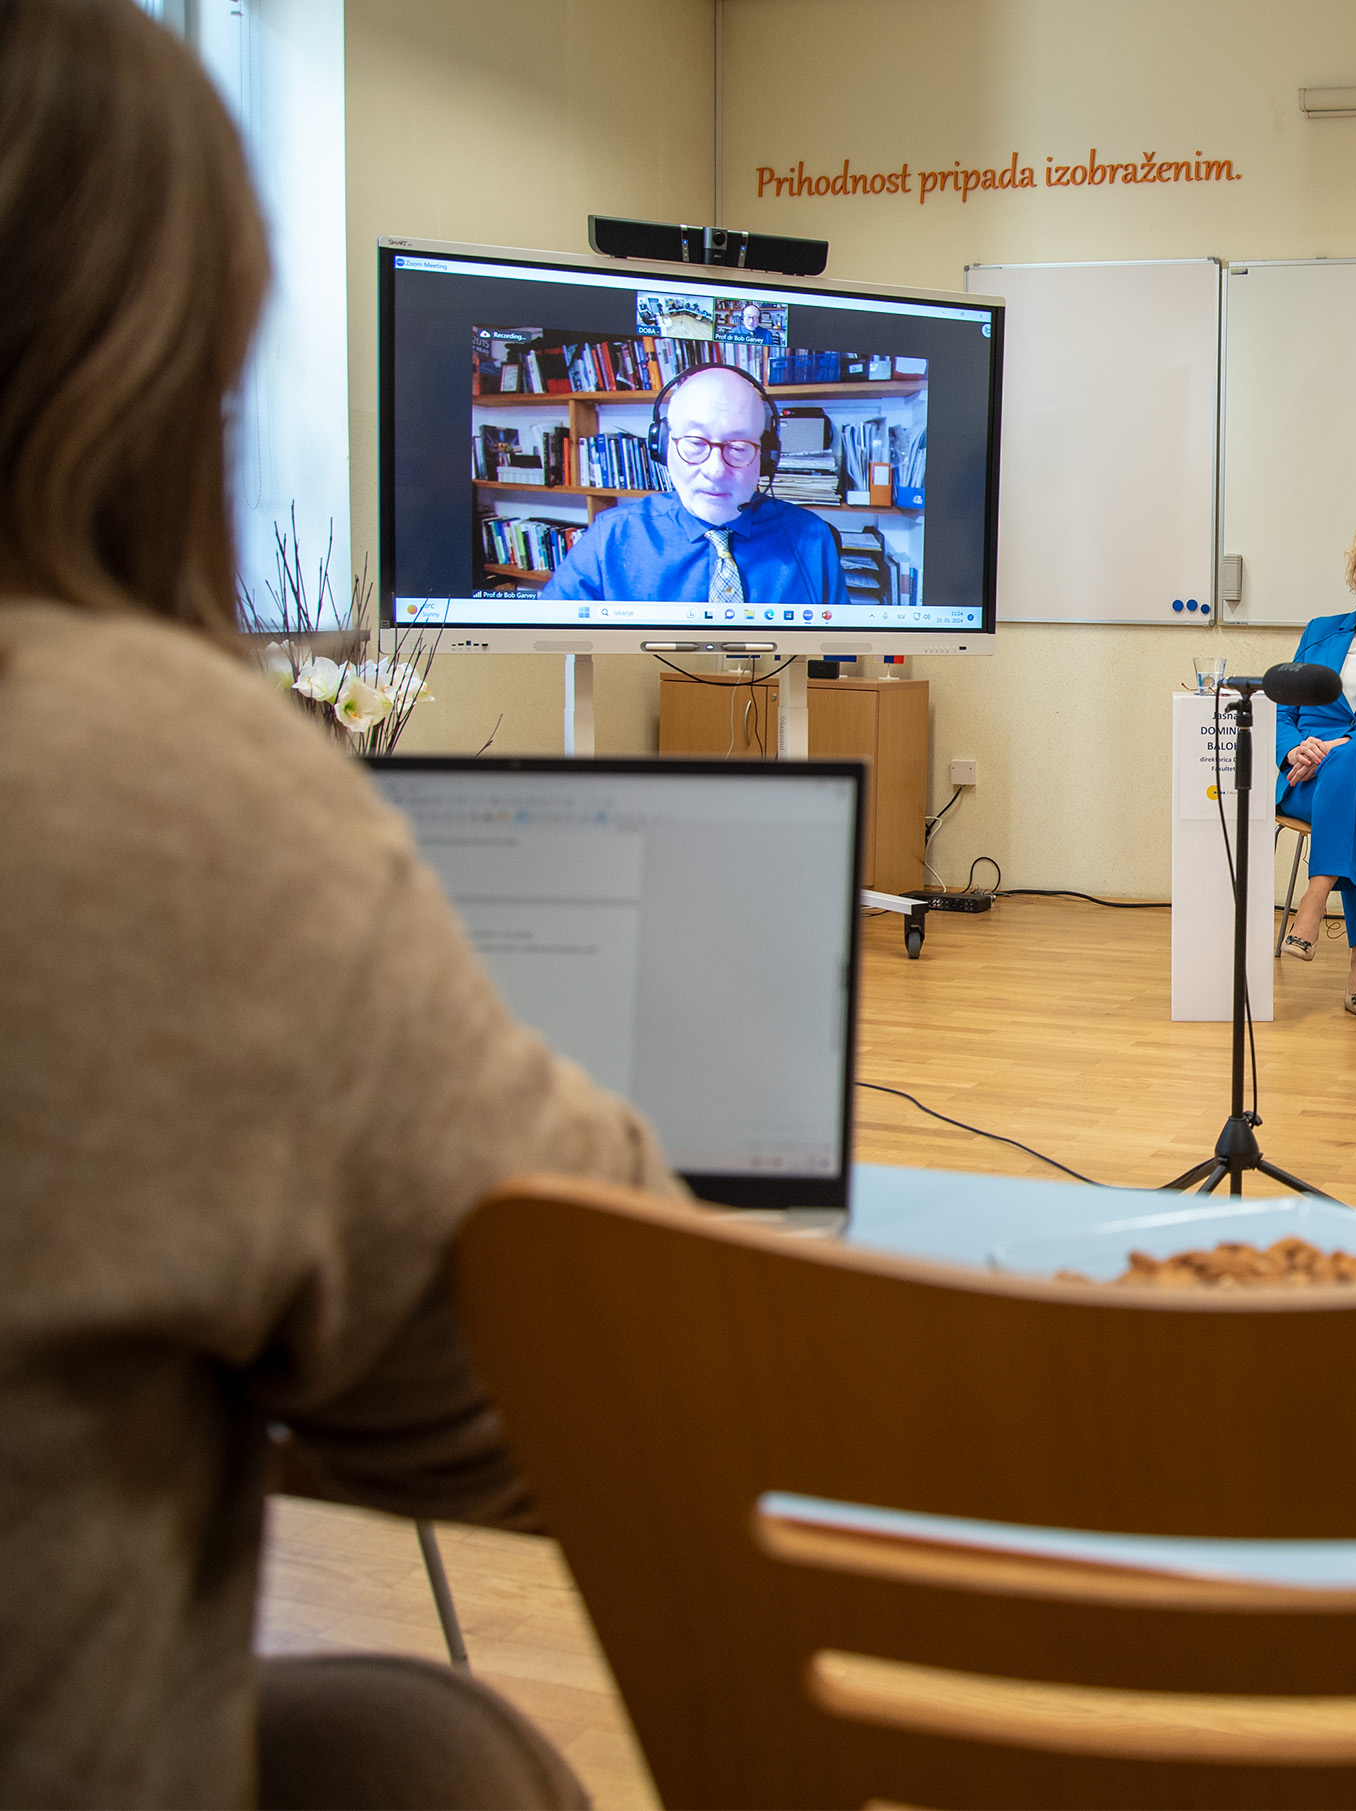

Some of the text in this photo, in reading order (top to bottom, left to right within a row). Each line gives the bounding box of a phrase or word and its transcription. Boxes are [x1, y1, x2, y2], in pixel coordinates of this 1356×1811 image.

[755, 148, 1242, 205] Prihodnost pripada izobraženim.
[424, 262, 447, 271] Meeting
[746, 336, 764, 344] Garvey
[517, 592, 536, 600] Garvey
[1201, 726, 1240, 735] DOMIN
